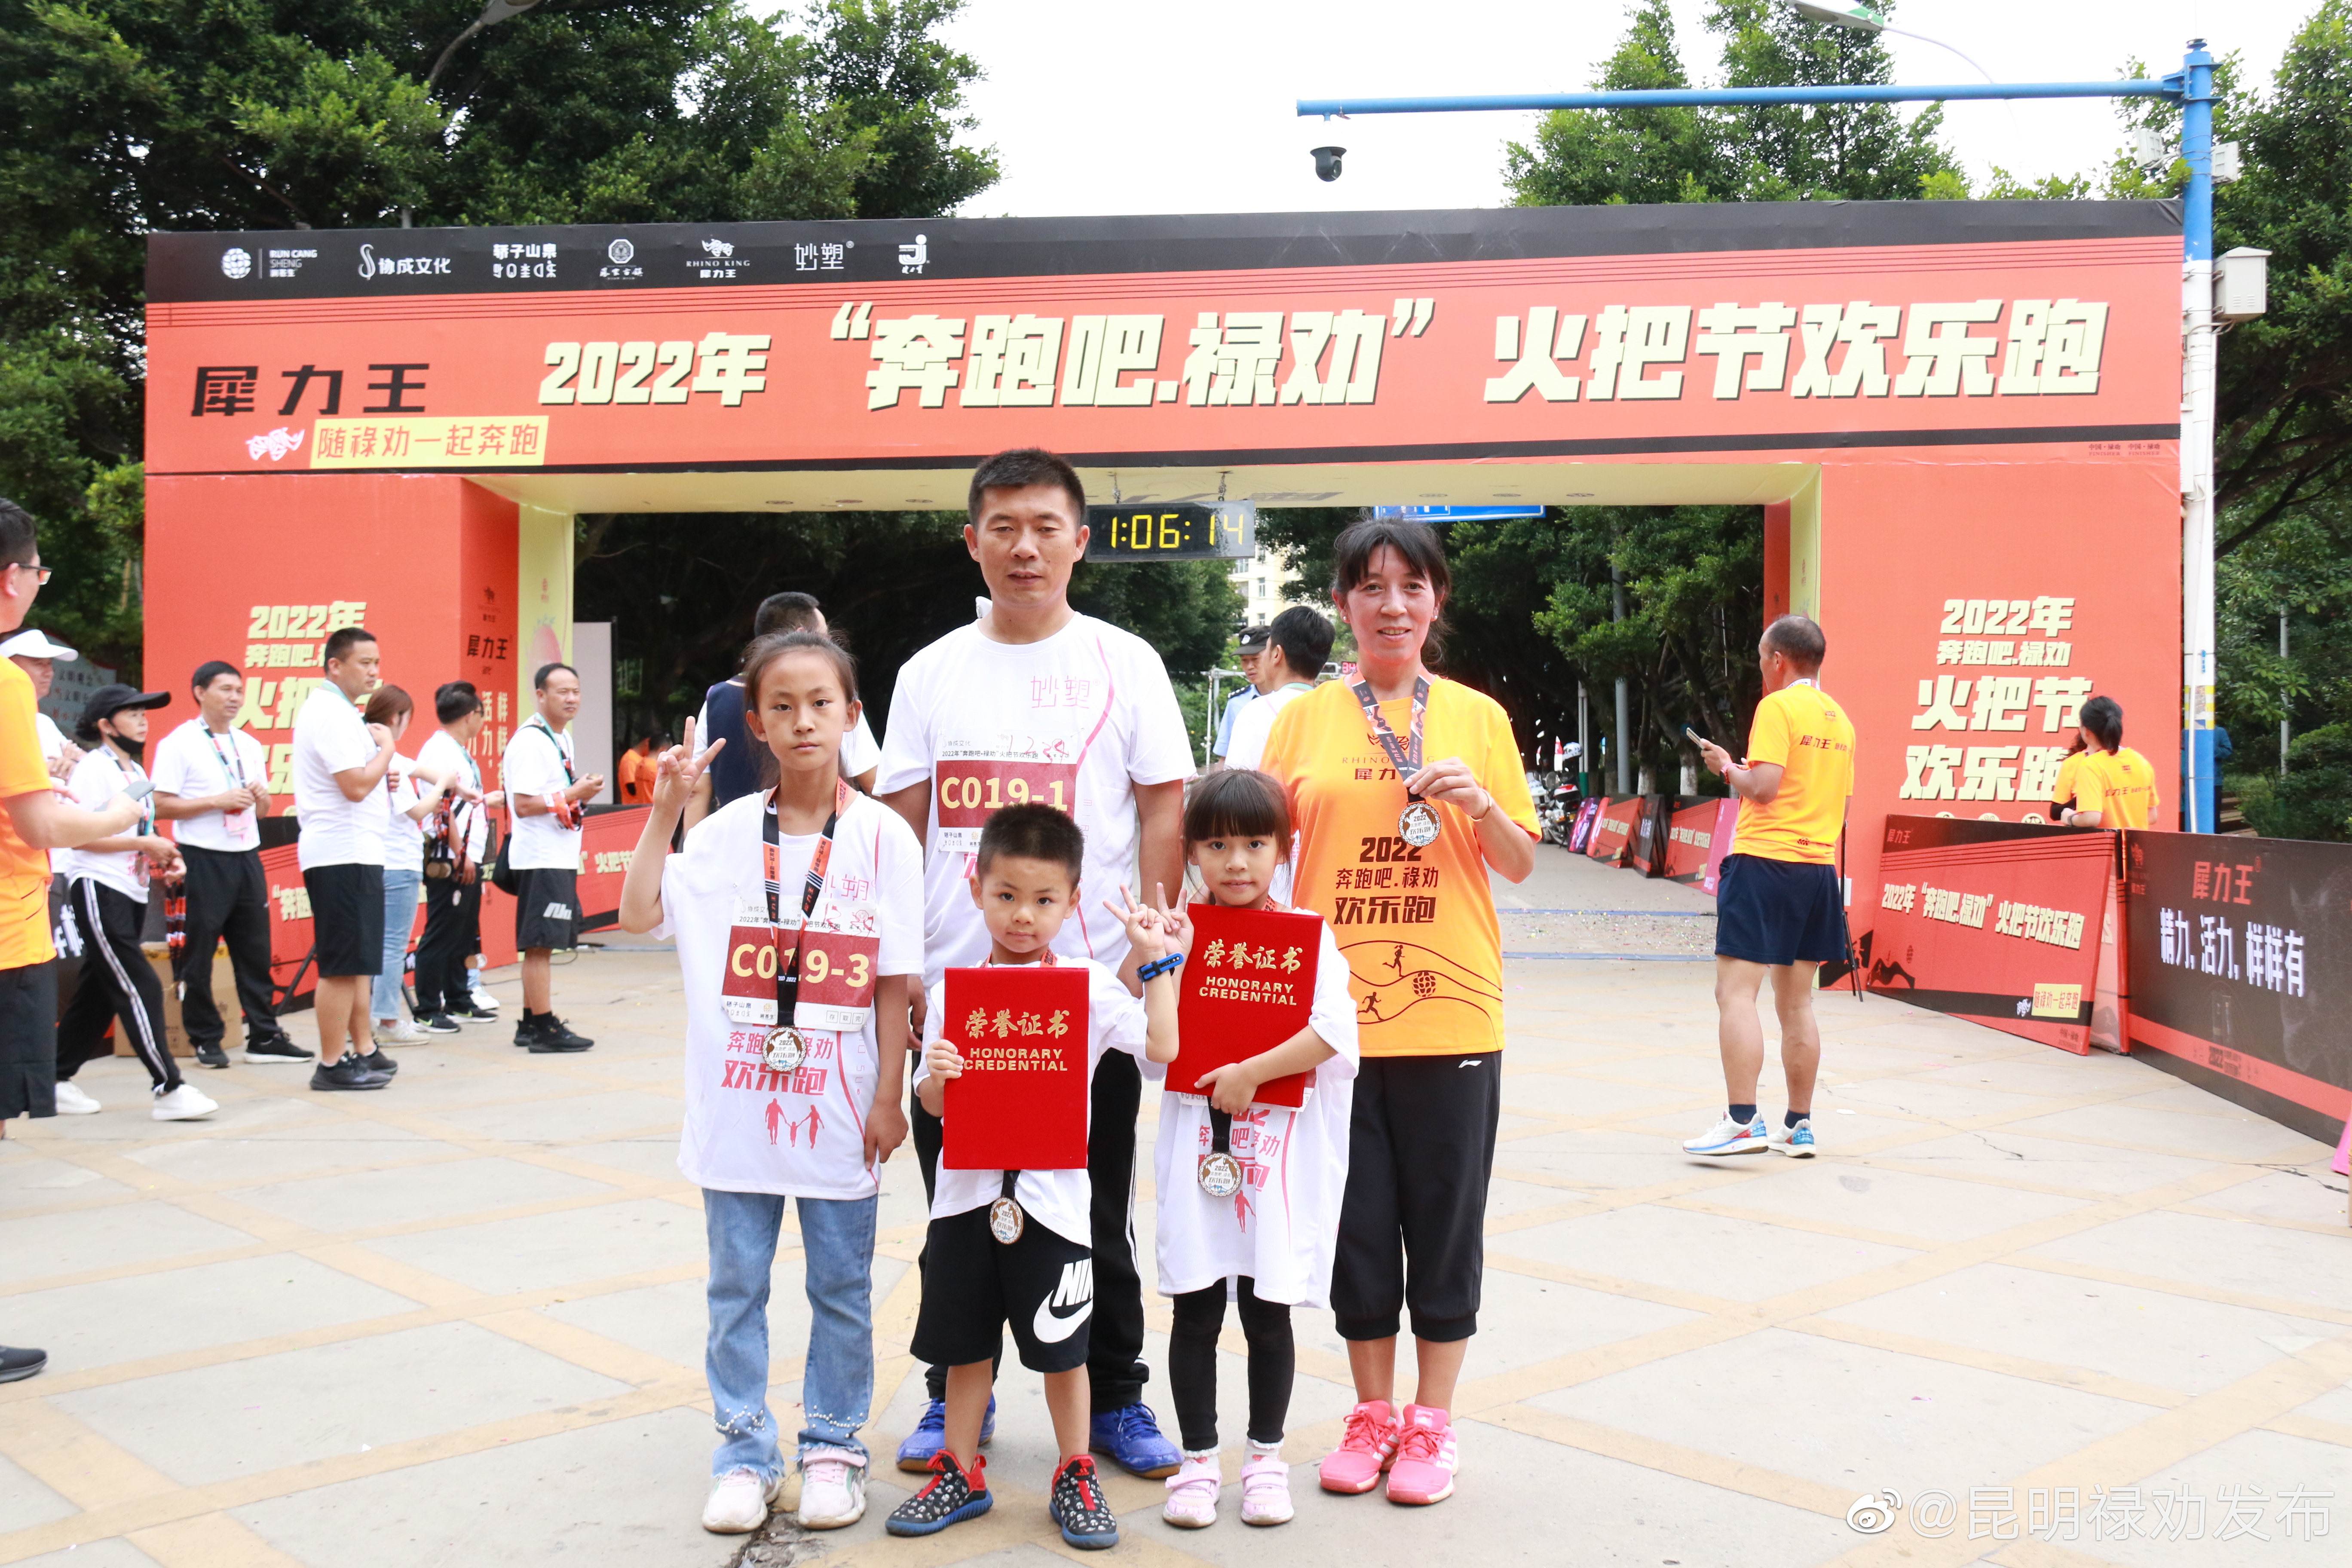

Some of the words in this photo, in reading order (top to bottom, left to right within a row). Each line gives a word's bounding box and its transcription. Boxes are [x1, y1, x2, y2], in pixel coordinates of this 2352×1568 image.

[269, 249, 290, 258] RUN
[291, 249, 318, 258] CANG
[270, 258, 302, 268] SHENG
[378, 257, 451, 275] 协成文化
[794, 243, 844, 270] 妙塑
[539, 332, 772, 407] 2022年
[1484, 298, 2110, 403] 火把节欢乐跑
[191, 364, 429, 417] 犀力王
[1940, 595, 2076, 637] 2022年
[467, 634, 508, 660] 犀力王
[1030, 675, 1090, 709] 妙塑
[1911, 674, 2093, 733] 火把节
[1355, 768, 1396, 781] 犀力
[940, 777, 1068, 811] C019-1
[1360, 837, 1422, 863] 2022
[1887, 829, 1911, 845] 犀力王
[2192, 861, 2254, 905] 犀力王
[1333, 896, 1436, 925] 欢乐跑
[1881, 883, 1916, 914] 2022年
[1995, 900, 2086, 950] 火把节欢乐跑
[1203, 939, 1303, 974] 荣誉证书
[1199, 987, 1297, 1006] CREDENTIAL
[1206, 976, 1293, 993] HONORARY
[965, 1007, 1070, 1039] 荣誉证书
[964, 1060, 1068, 1071] CREDENTIAL
[970, 1047, 1063, 1059] HONORARY
[720, 1060, 828, 1096] 欢乐跑
